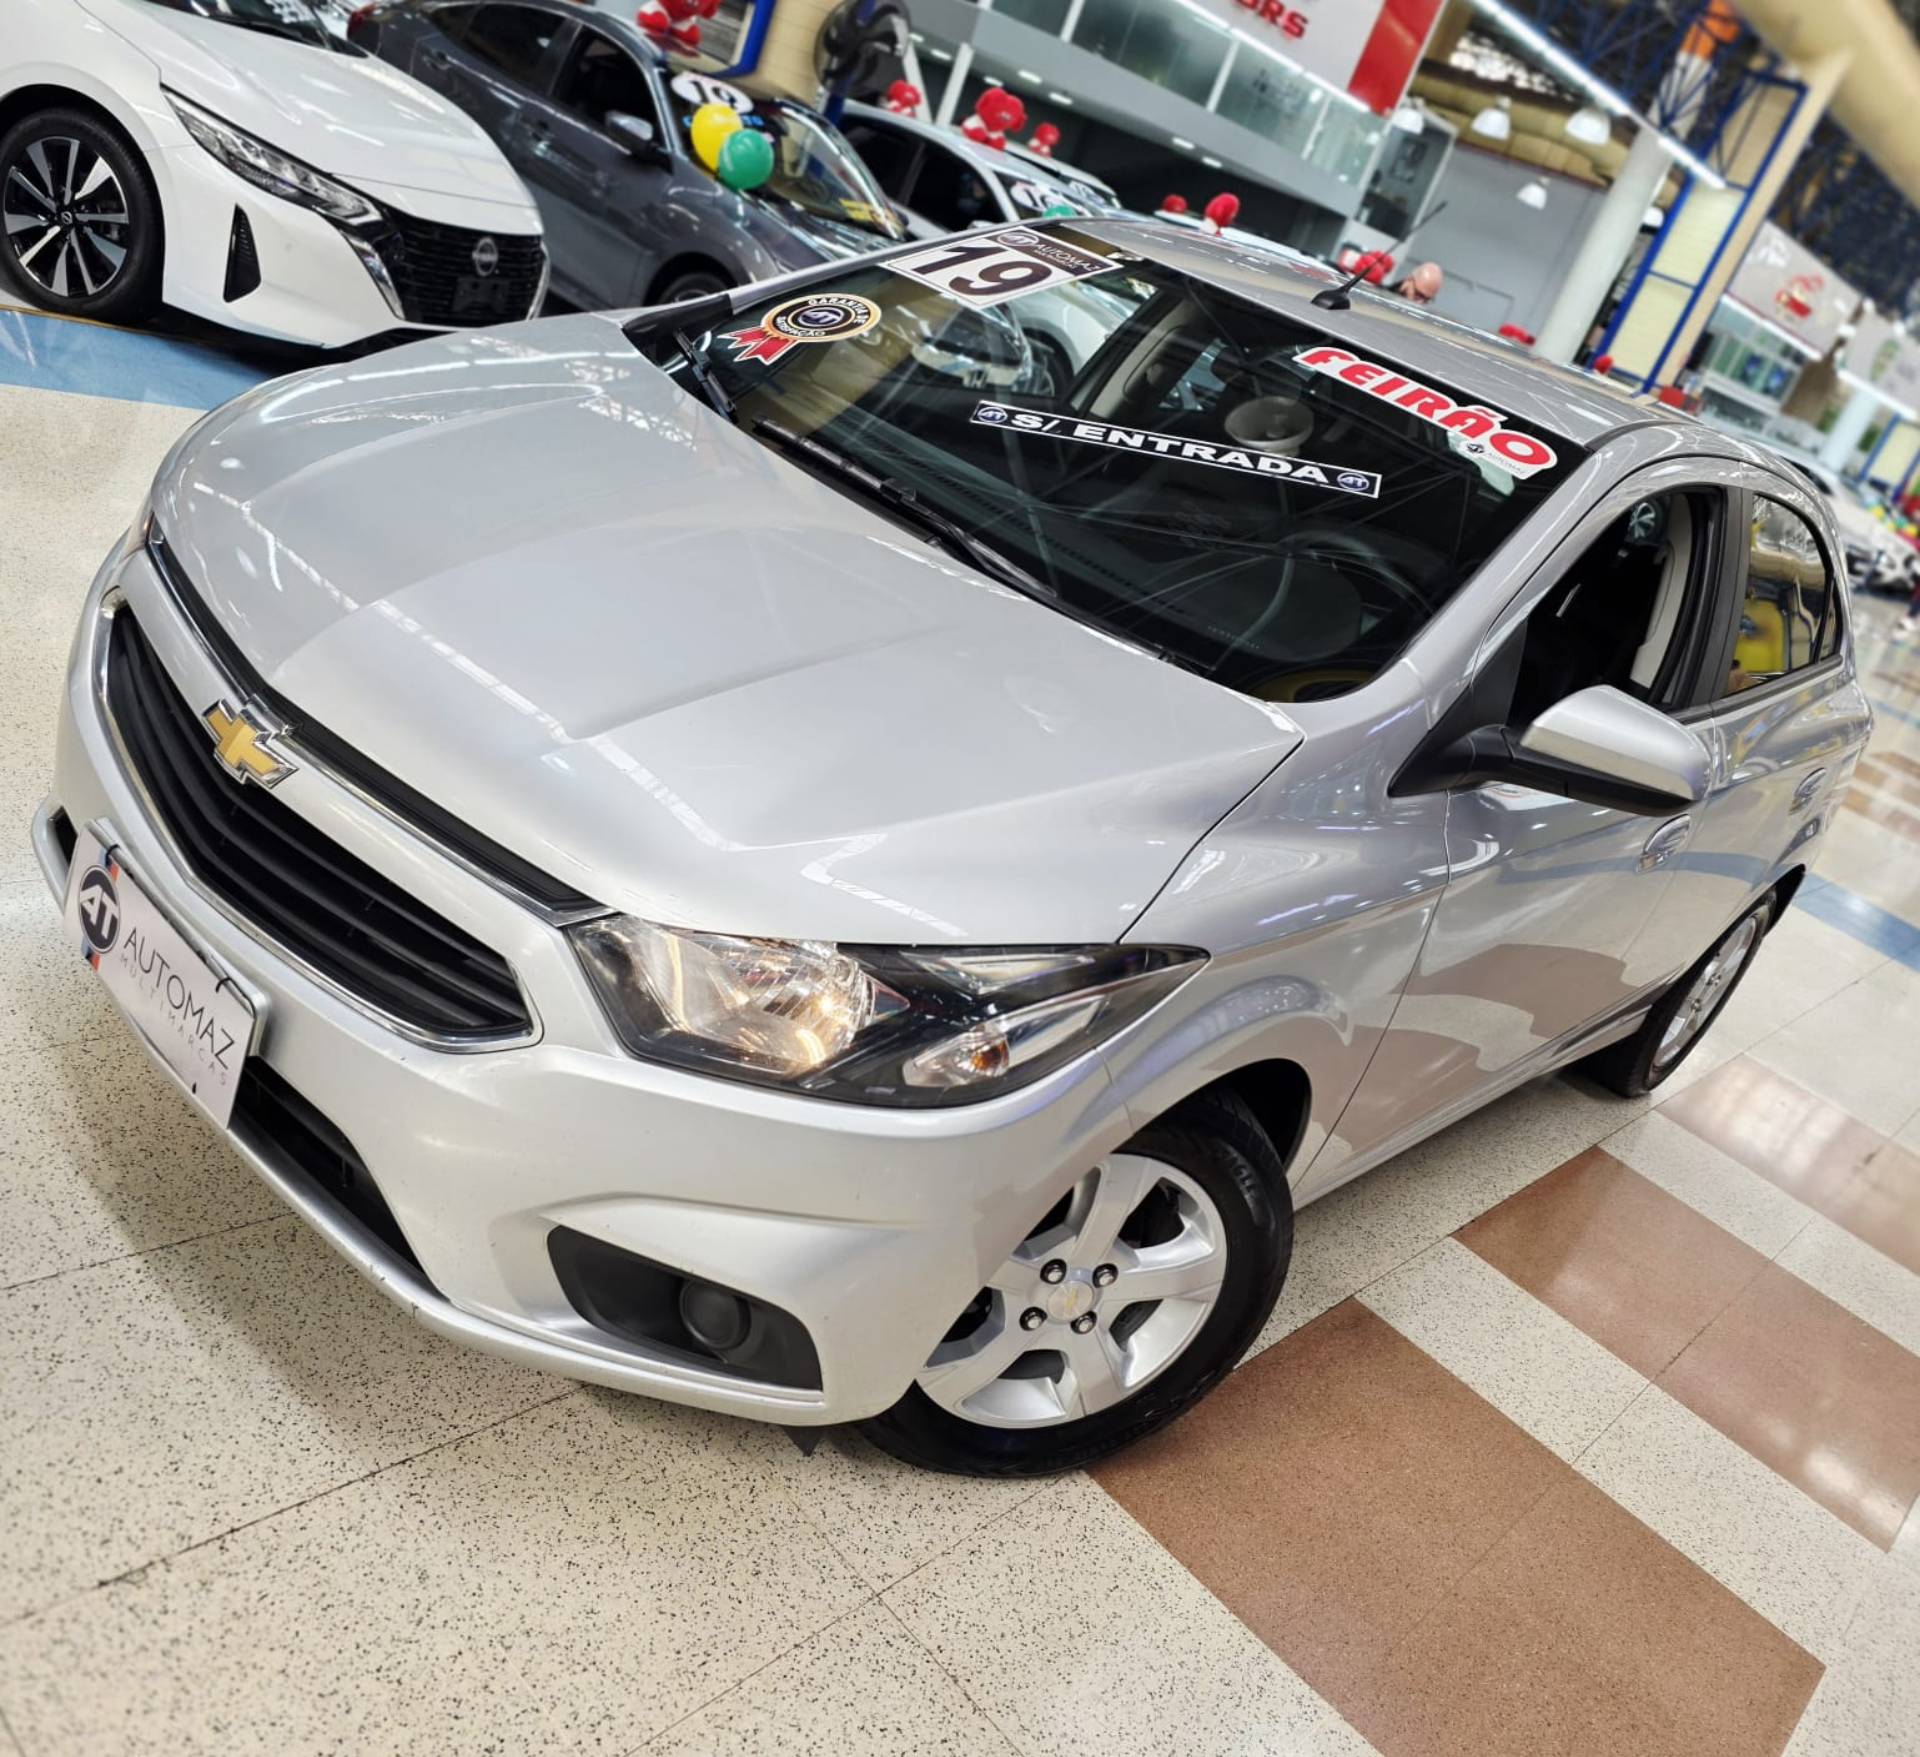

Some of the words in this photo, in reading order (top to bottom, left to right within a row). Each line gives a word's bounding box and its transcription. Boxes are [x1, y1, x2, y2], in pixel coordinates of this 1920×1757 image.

[911, 246, 1052, 296] 19
[1300, 349, 1552, 466] FEIRÃO
[1073, 426, 1328, 484] ENTRADA
[123, 926, 236, 1070] AUTOMAZ
